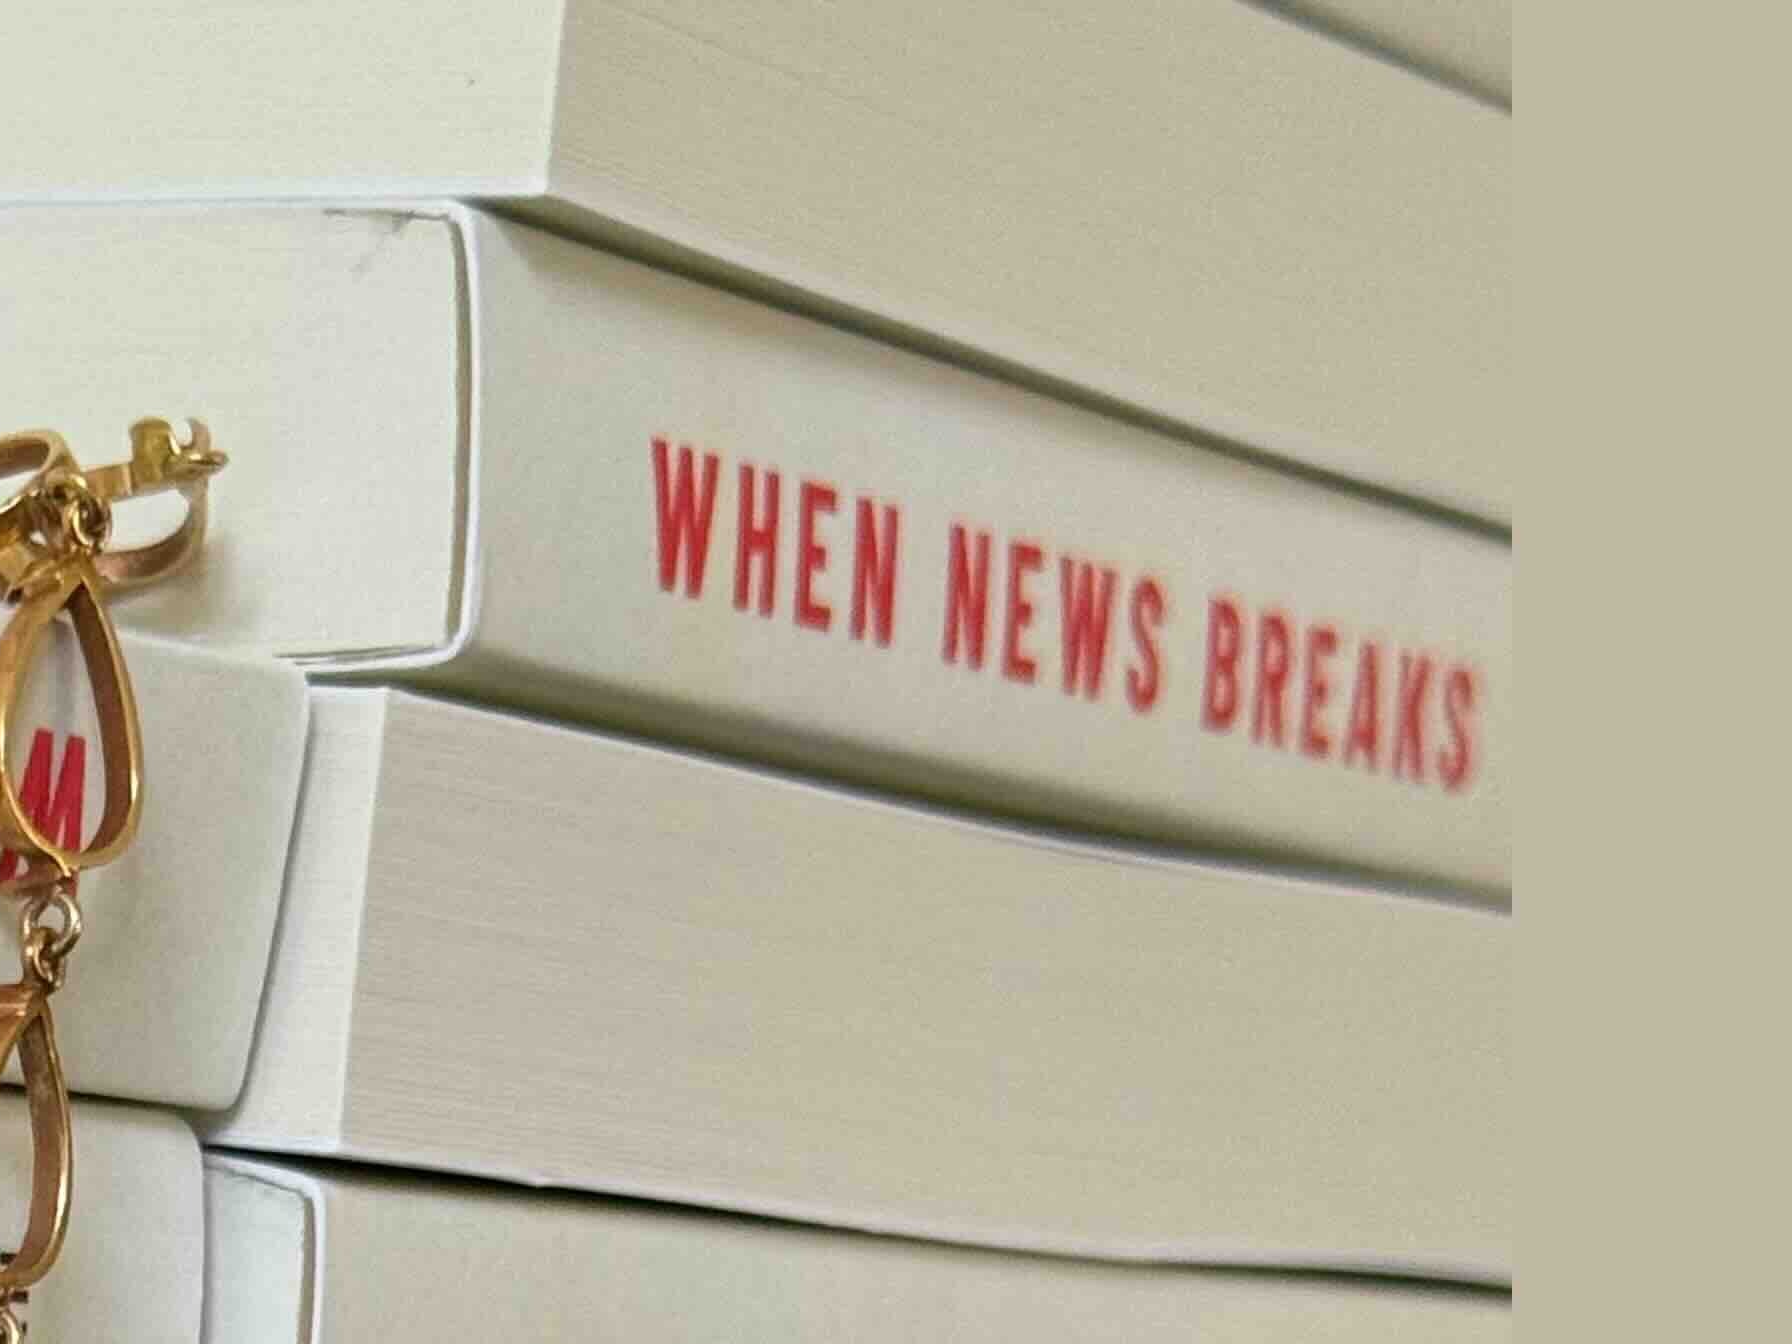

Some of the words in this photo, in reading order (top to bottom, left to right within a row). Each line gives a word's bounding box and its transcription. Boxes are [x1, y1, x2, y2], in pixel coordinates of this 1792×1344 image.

[651, 438, 899, 645] WHEN
[945, 525, 1167, 712] NEWS
[1200, 597, 1477, 796] BREAKS
